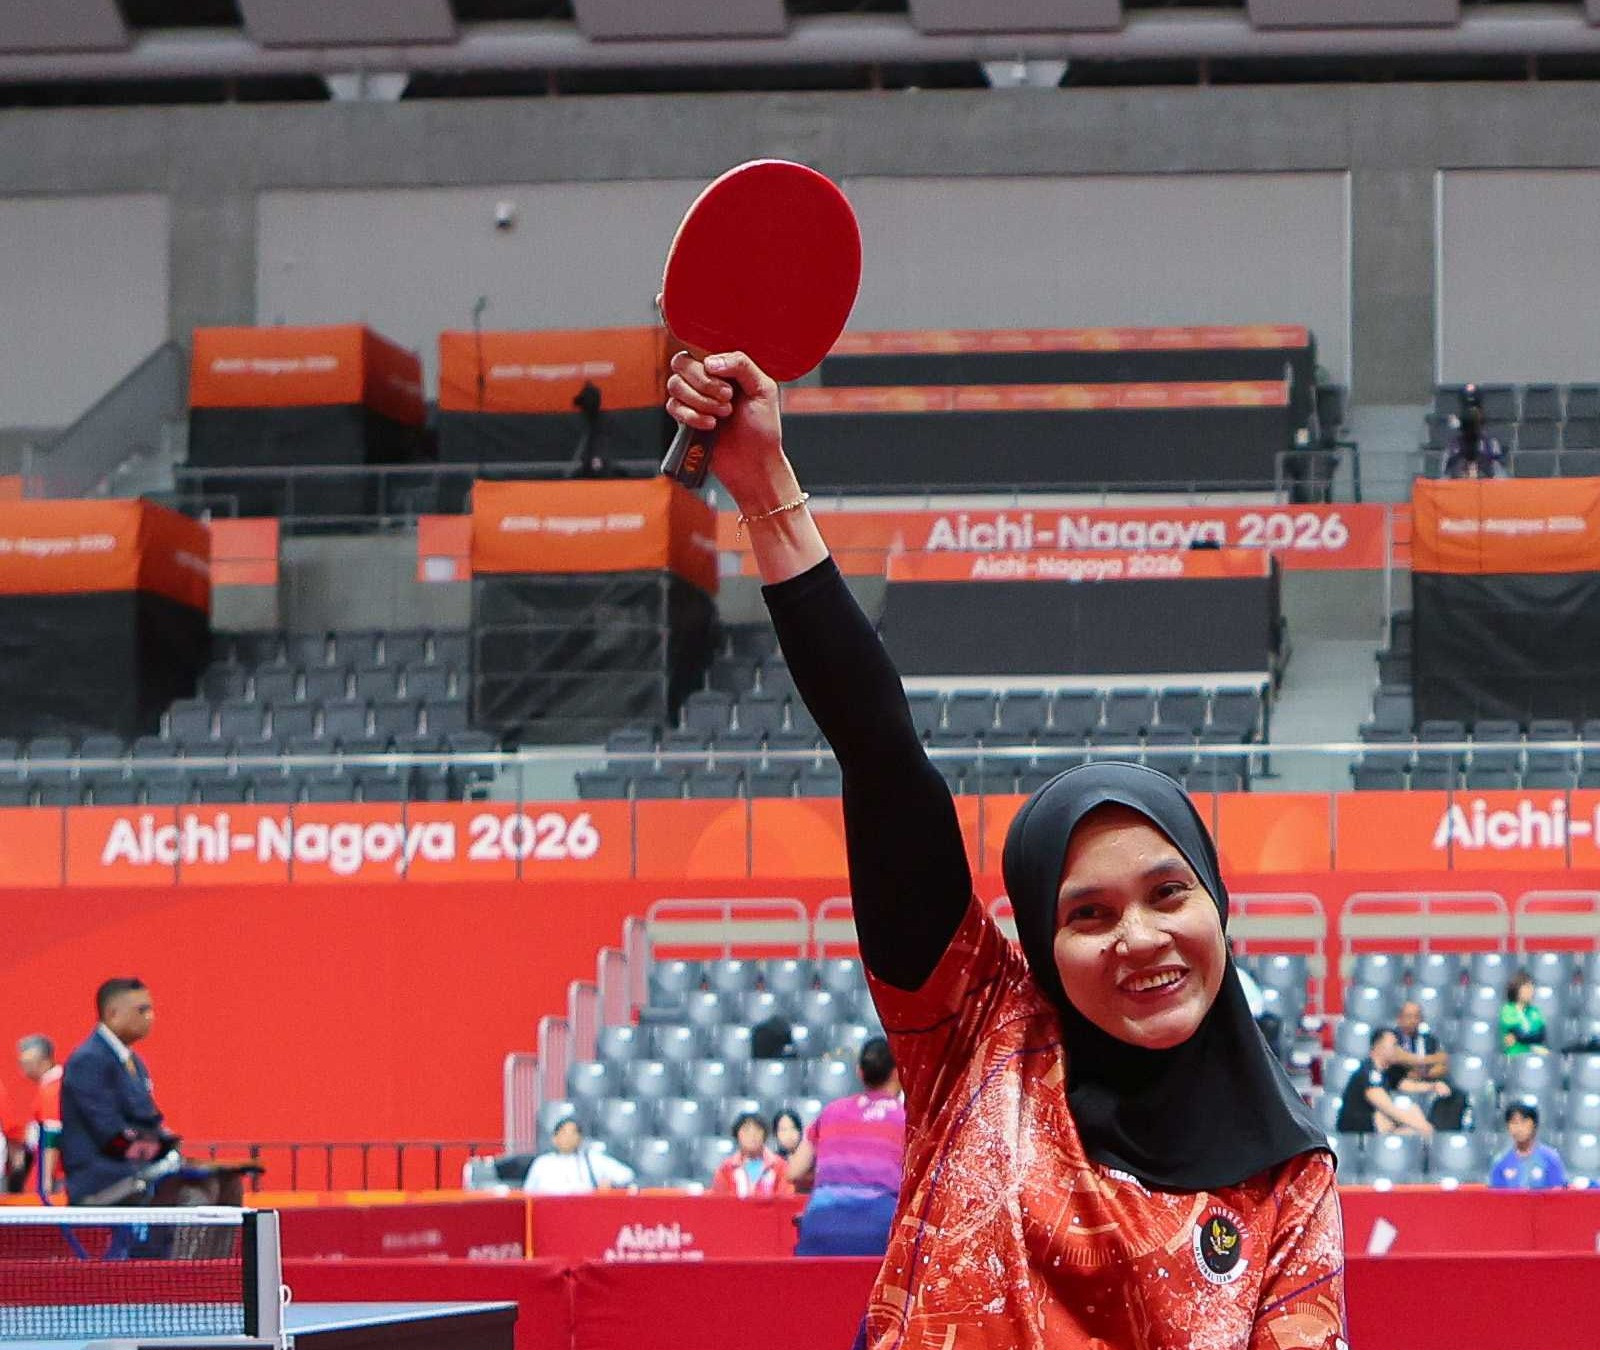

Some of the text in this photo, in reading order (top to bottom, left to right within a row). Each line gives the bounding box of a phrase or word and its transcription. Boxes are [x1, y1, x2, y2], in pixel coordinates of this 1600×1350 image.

[1239, 513, 1349, 550] 2026
[1128, 554, 1184, 577] 2026
[102, 812, 601, 873] Aichi-Nagoya 2026
